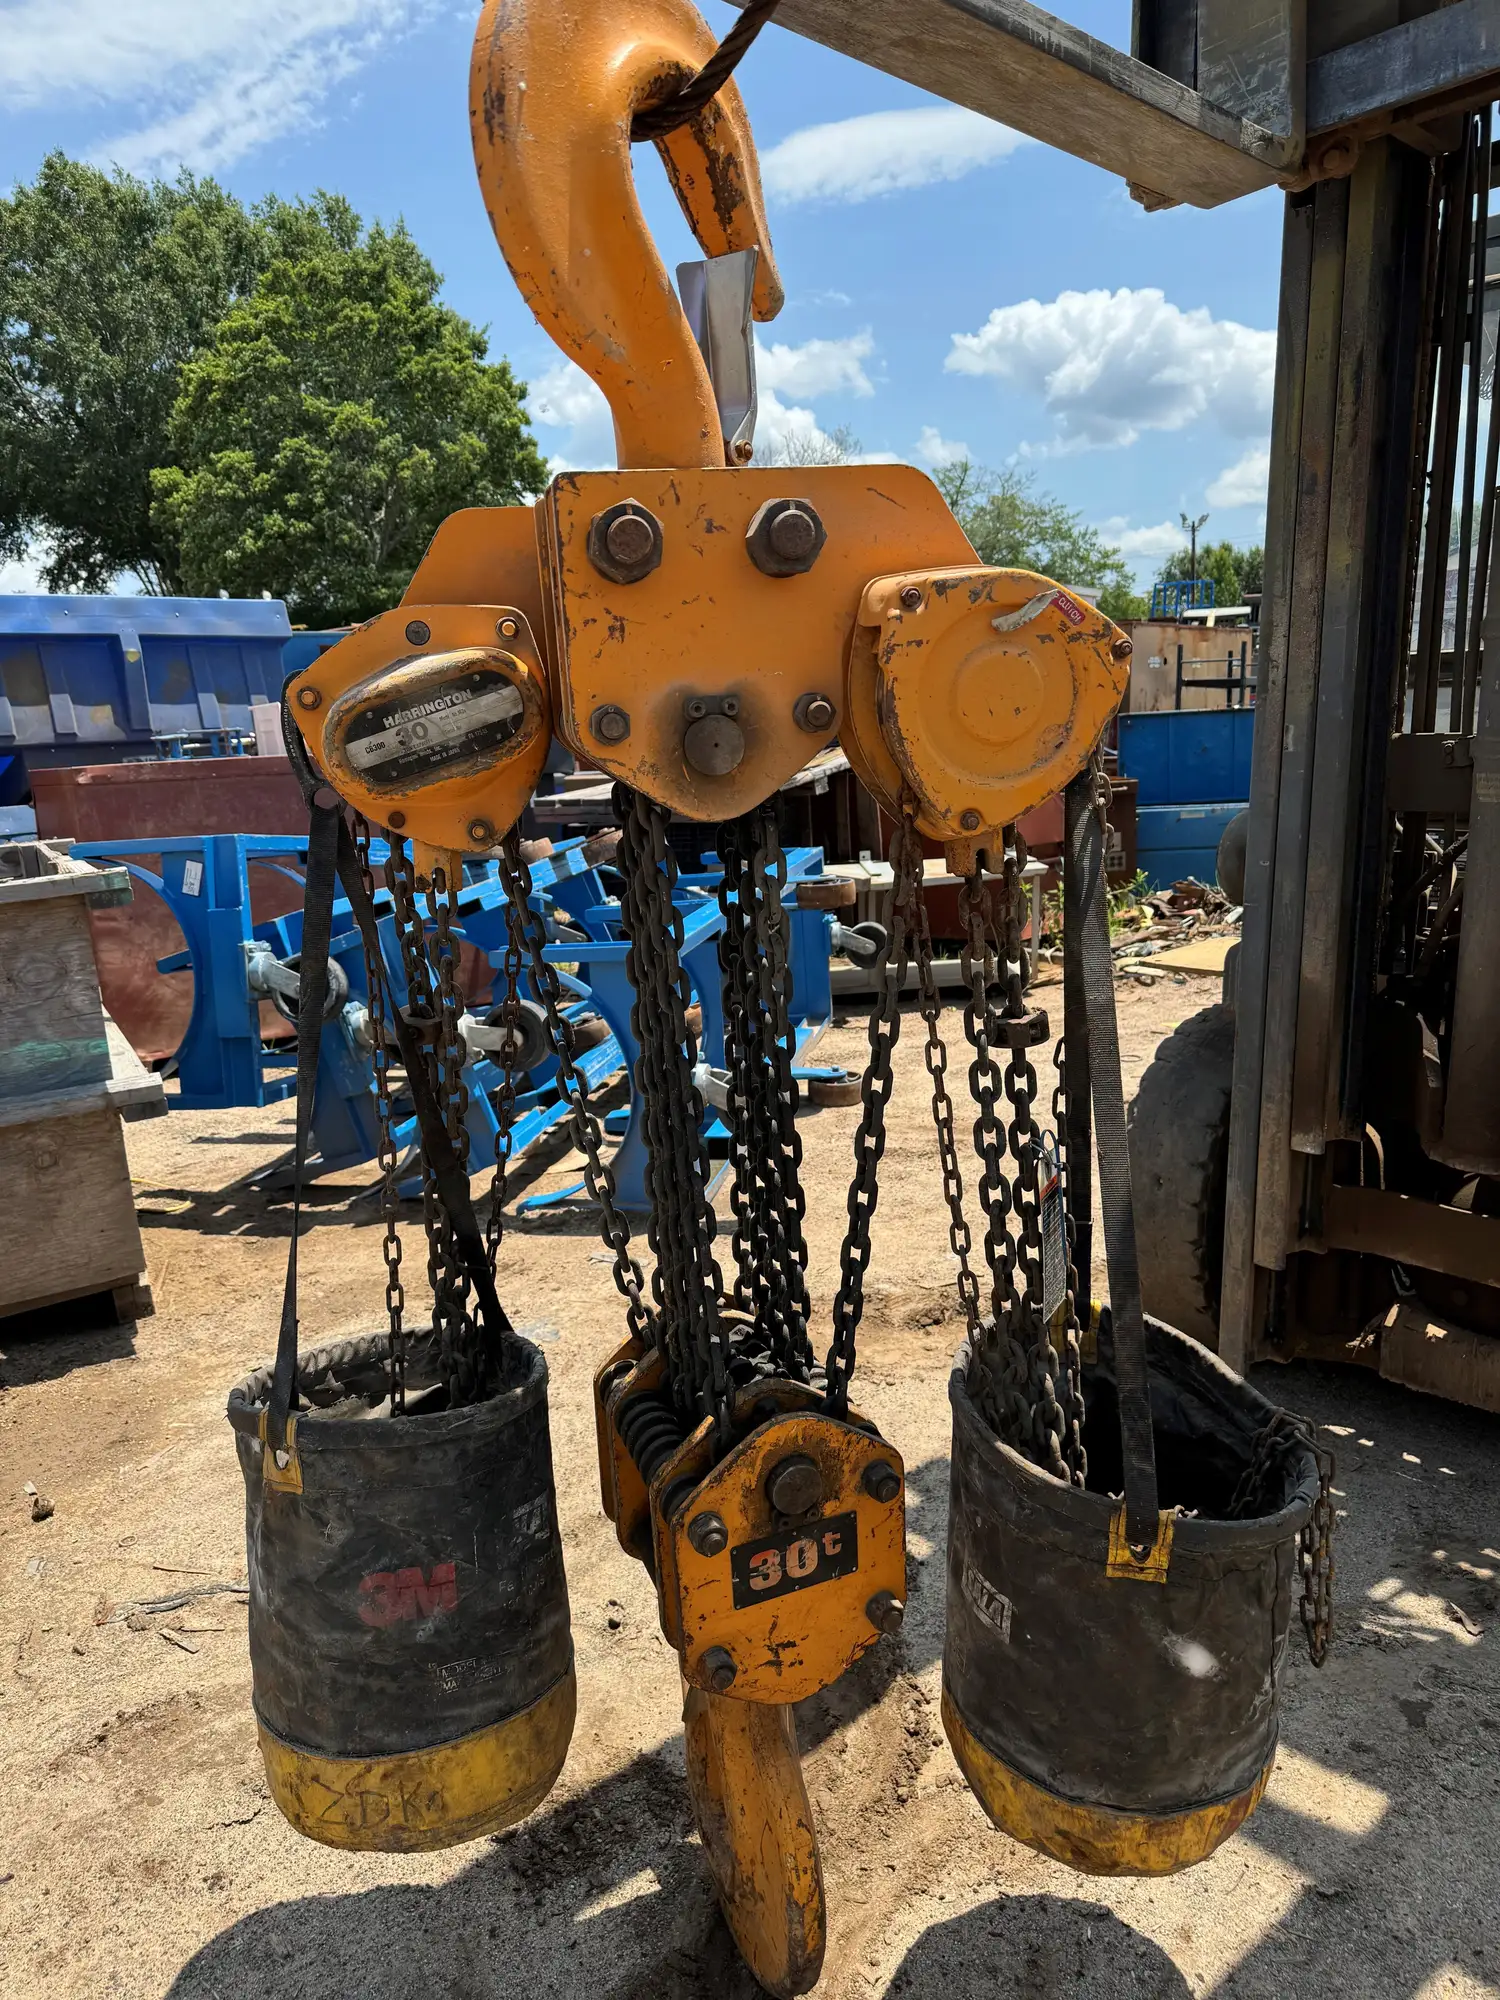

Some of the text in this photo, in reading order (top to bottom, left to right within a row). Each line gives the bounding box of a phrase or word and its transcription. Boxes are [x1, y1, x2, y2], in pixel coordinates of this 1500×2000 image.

[382, 689, 473, 728] HARRINGTON
[395, 722, 428, 746] 30
[357, 1561, 458, 1629] 3M
